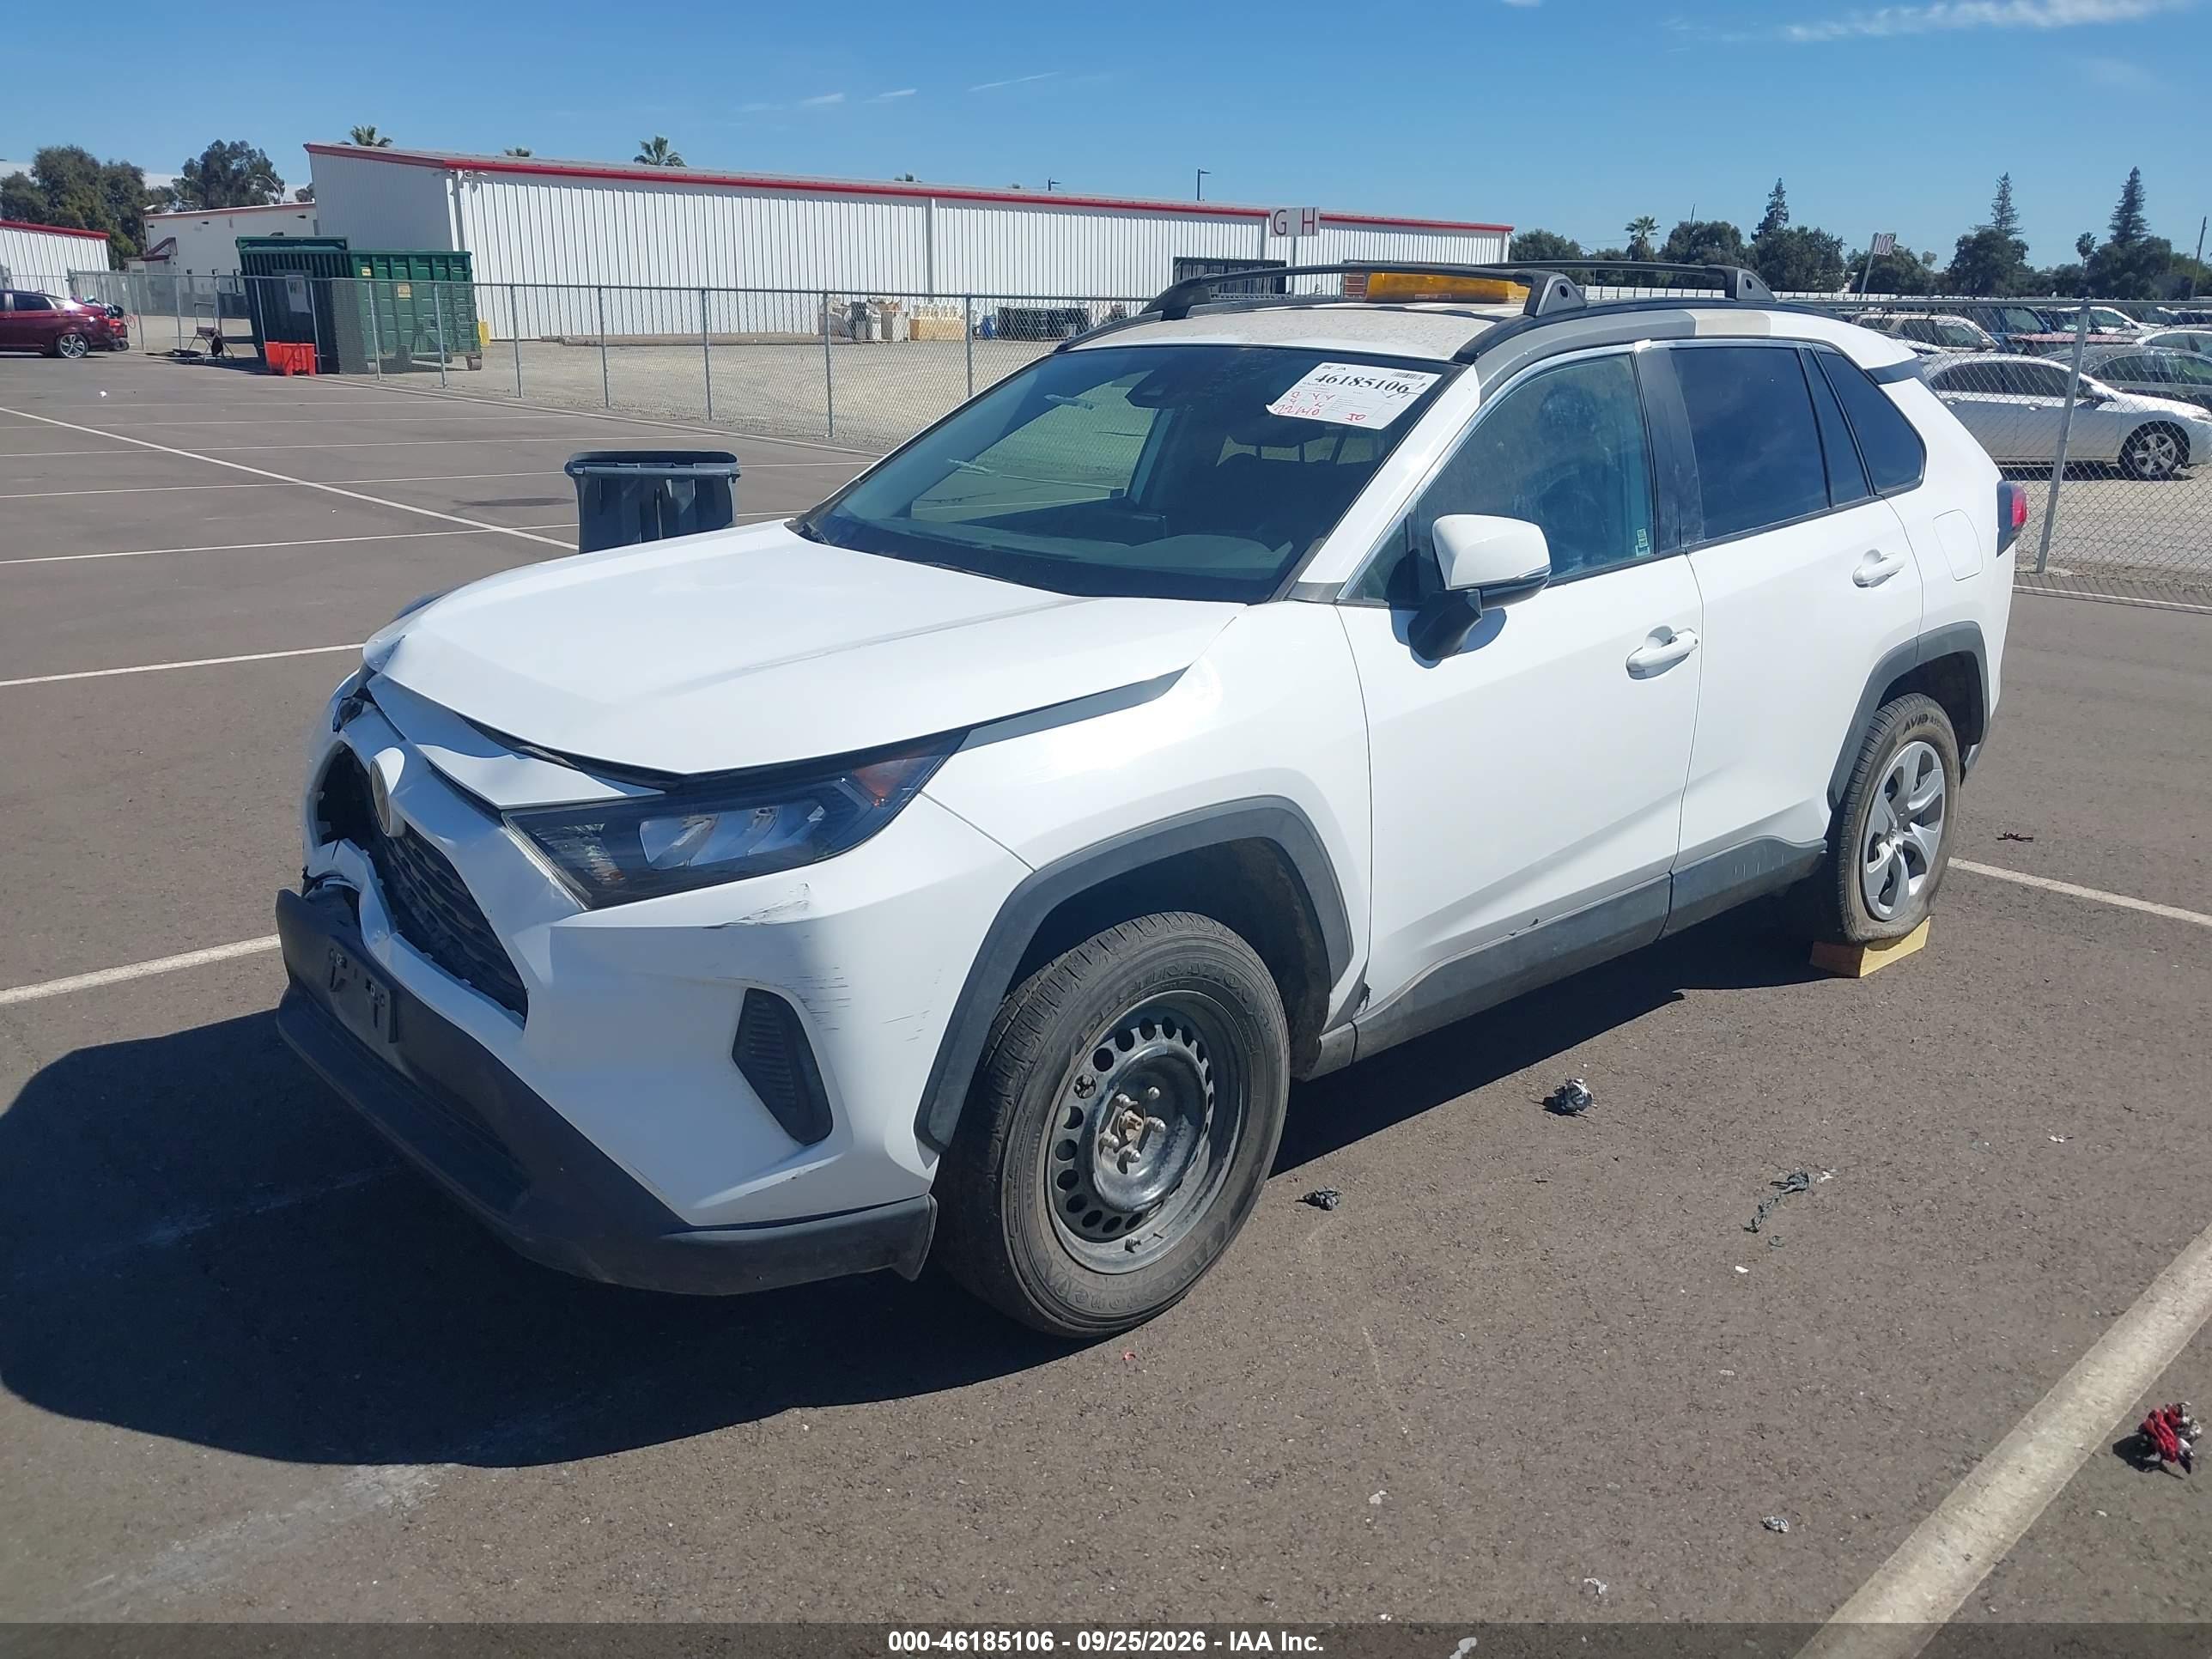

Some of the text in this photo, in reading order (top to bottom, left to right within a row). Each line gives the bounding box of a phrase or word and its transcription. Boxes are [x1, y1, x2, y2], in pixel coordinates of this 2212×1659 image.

[1273, 208, 1316, 235] G H
[1876, 234, 1892, 255] 100
[1314, 374, 1414, 393] 46185106
